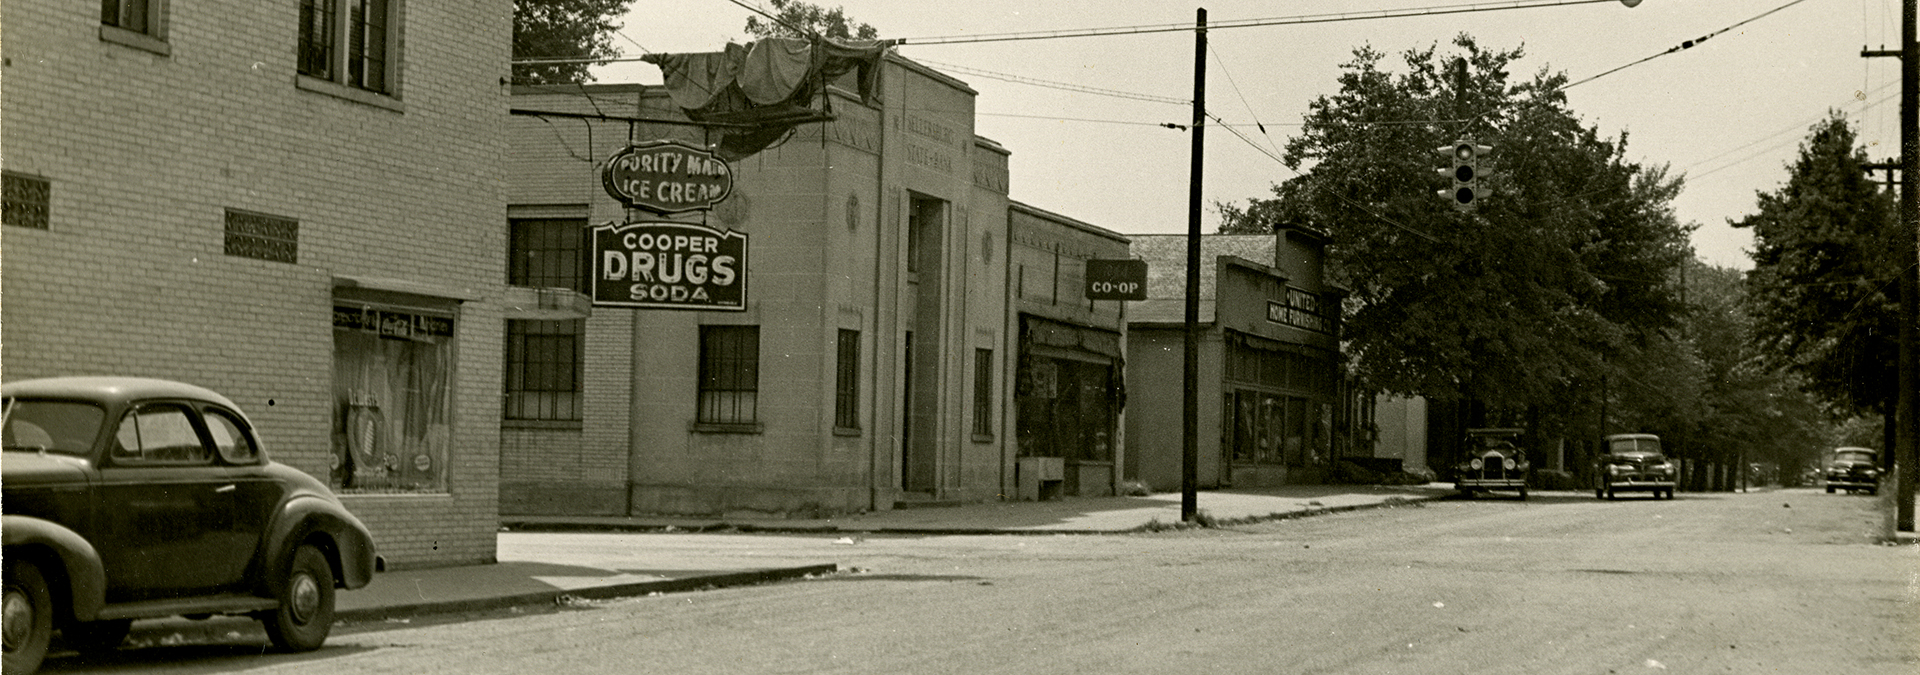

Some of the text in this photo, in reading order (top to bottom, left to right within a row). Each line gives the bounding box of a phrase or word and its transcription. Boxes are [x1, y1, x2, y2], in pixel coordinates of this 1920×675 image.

[620, 152, 683, 174] PURITY
[623, 179, 722, 203] ICE CREAM
[623, 232, 718, 253] COOPER
[603, 250, 736, 286] DRUGS
[630, 284, 711, 303] SODA
[1092, 281, 1139, 294] CO-OP
[1289, 289, 1316, 312] UNITED
[1269, 303, 1288, 323] HOME
